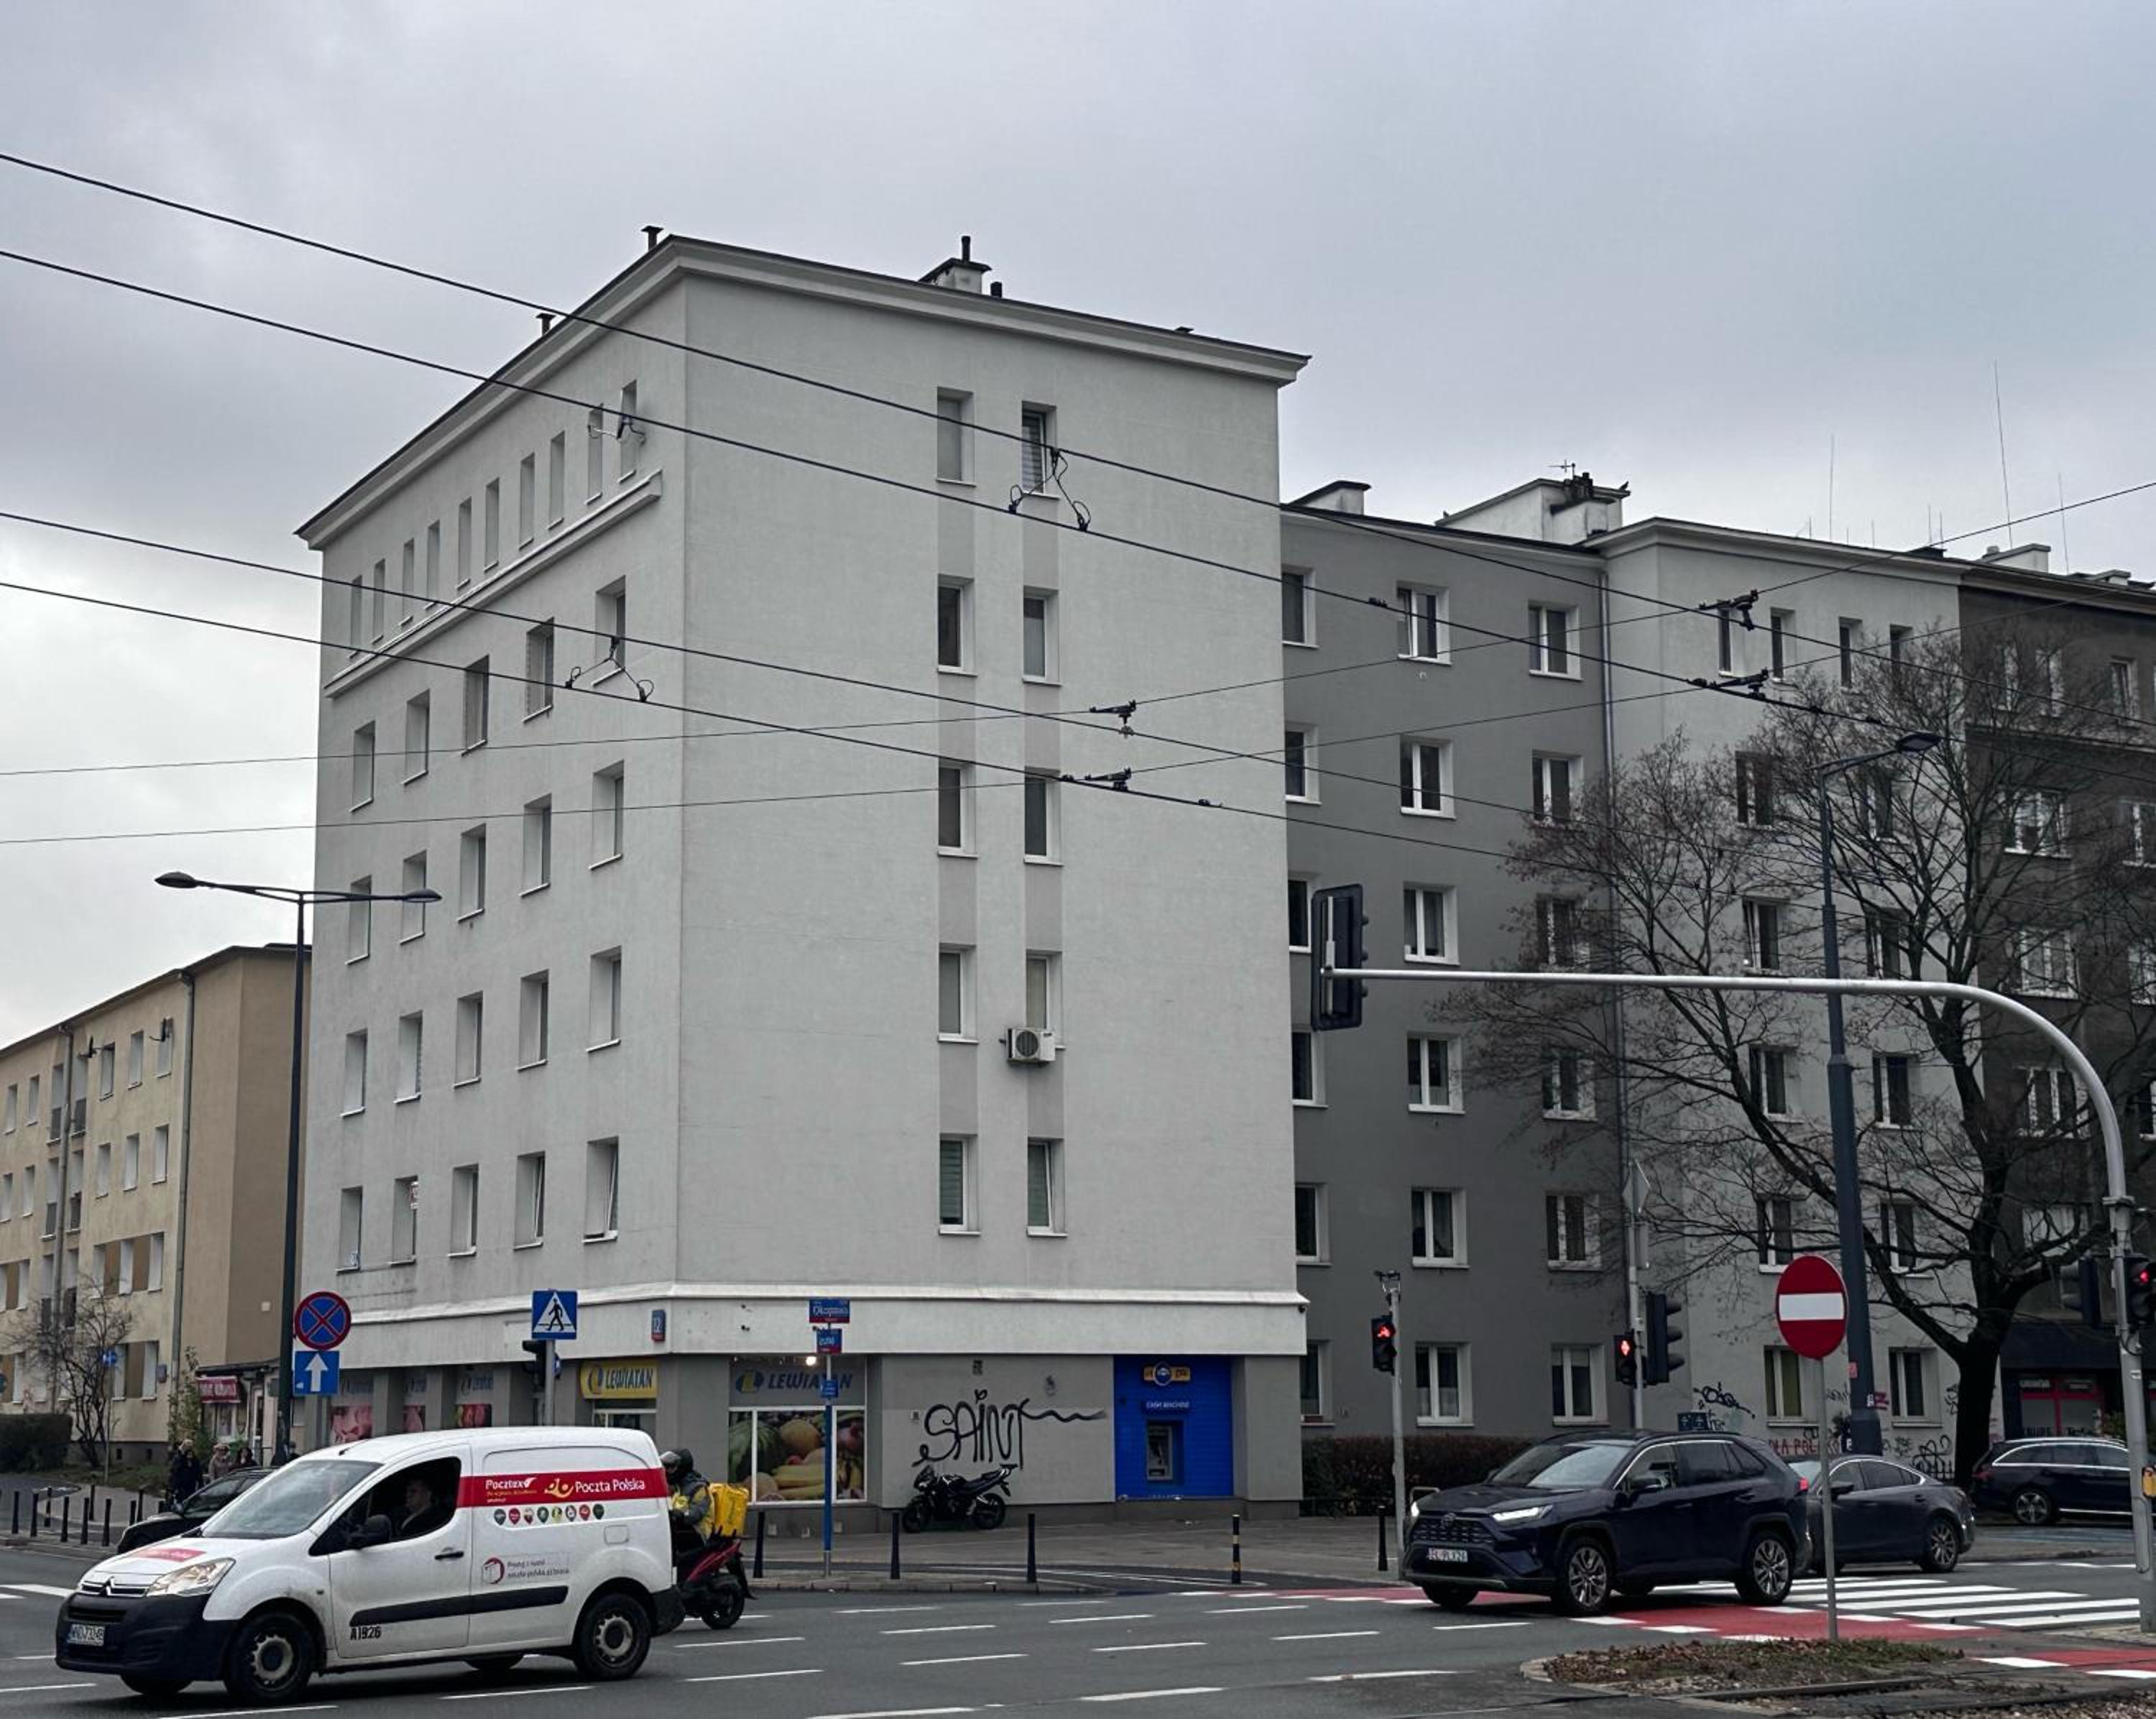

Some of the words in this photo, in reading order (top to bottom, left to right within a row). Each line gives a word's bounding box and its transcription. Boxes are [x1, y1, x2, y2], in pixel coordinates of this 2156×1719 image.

[606, 1368, 653, 1389] LEWIATAN
[574, 1480, 610, 1493] Poczta
[612, 1478, 645, 1492] Polska
